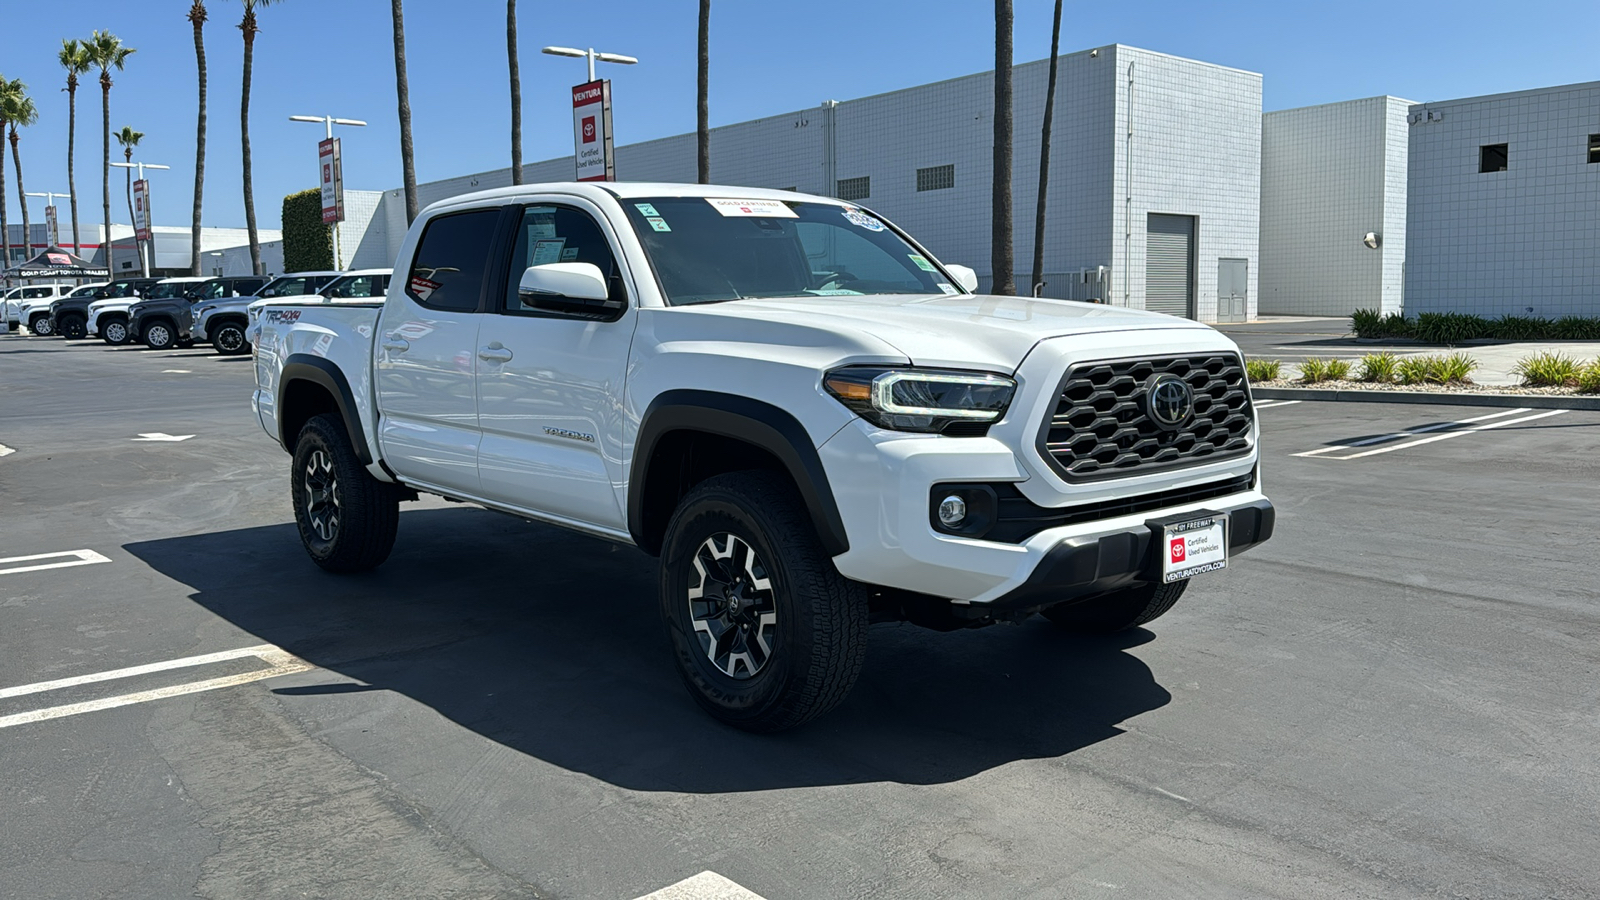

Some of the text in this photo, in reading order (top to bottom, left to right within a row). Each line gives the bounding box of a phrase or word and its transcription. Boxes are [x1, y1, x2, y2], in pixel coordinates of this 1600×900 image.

[574, 88, 601, 102] VENTURA
[581, 147, 599, 158] Certified
[542, 425, 595, 443] TACOMA
[1187, 519, 1212, 530] FREEWAY
[1188, 536, 1208, 547] Certified
[1188, 544, 1219, 556] Used Vehicles
[1166, 561, 1226, 581] VENTURATOYOTA.COM
